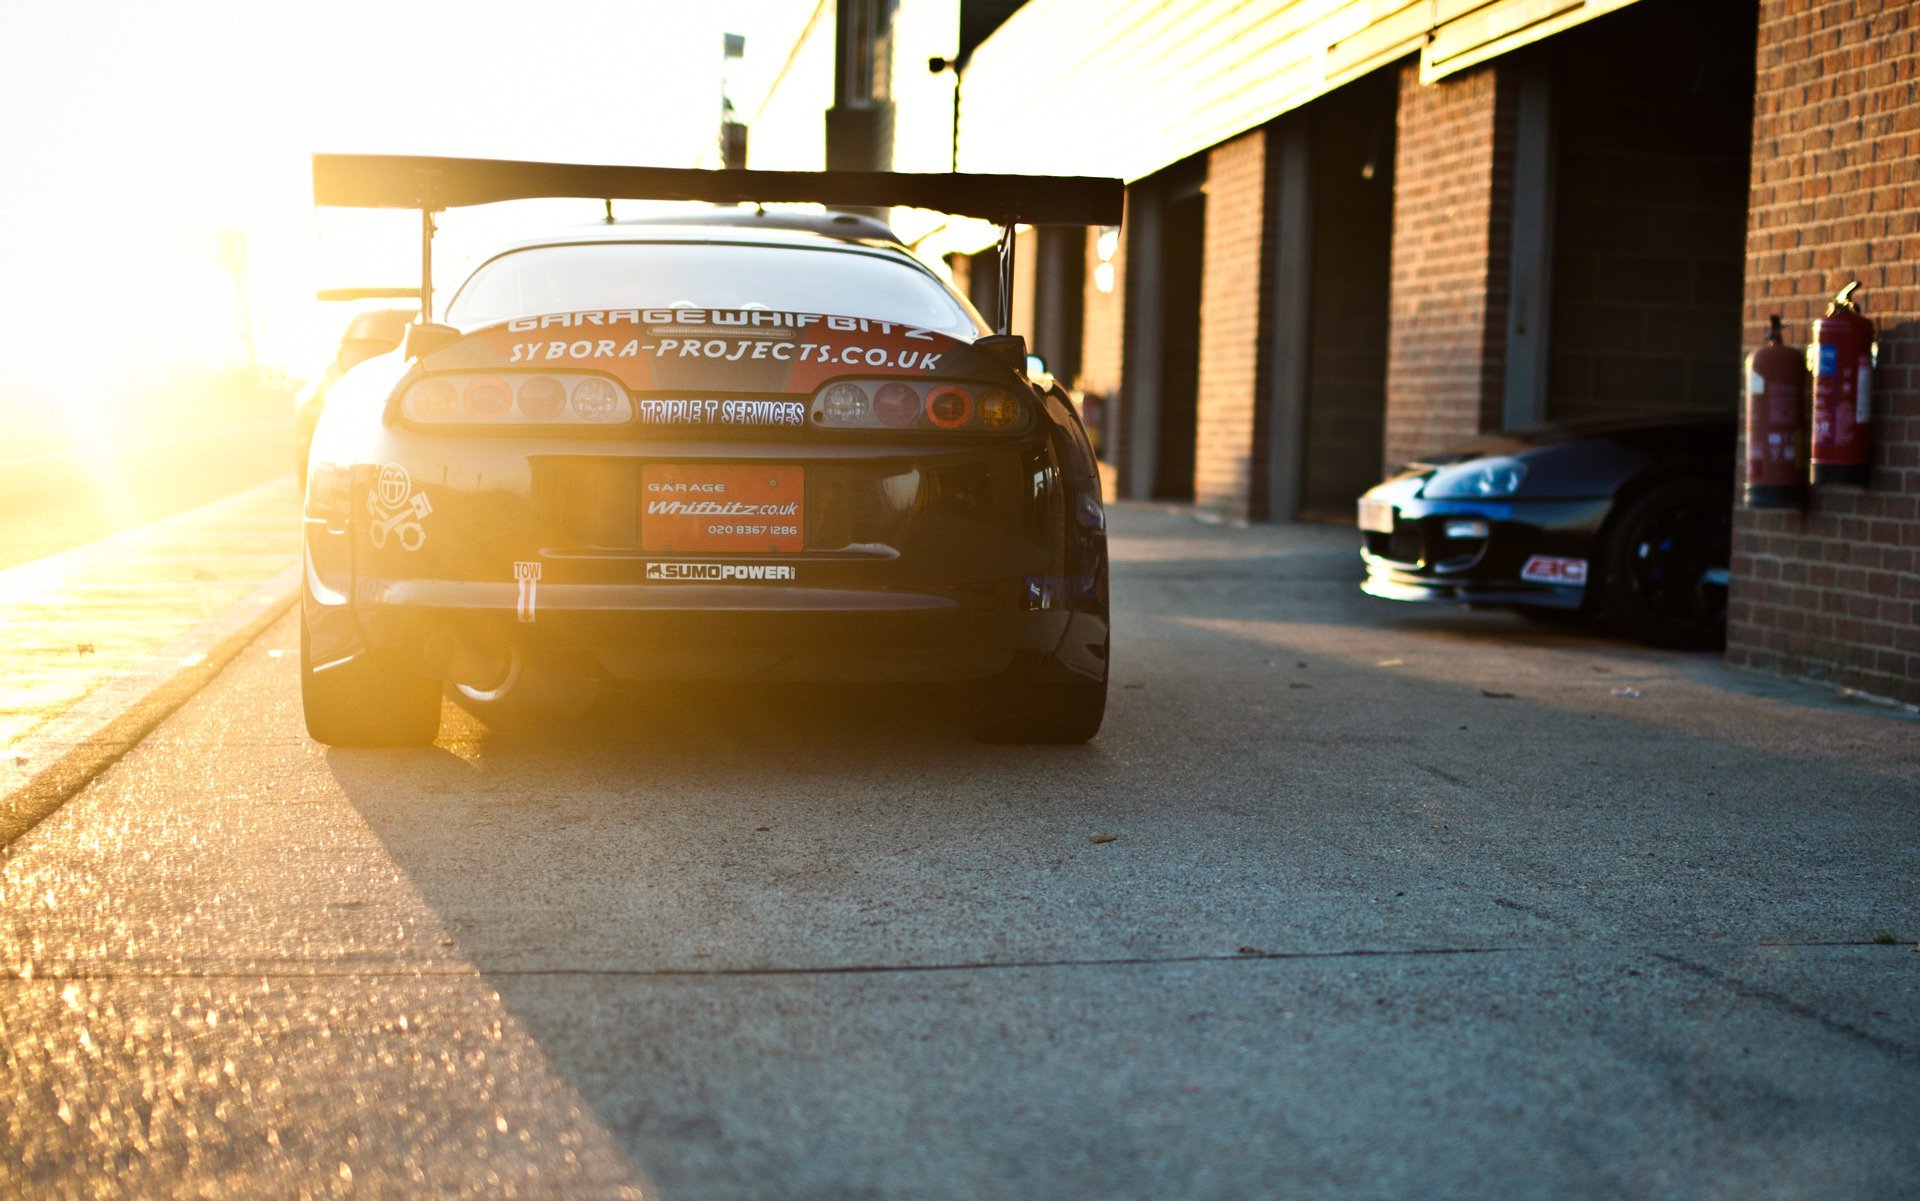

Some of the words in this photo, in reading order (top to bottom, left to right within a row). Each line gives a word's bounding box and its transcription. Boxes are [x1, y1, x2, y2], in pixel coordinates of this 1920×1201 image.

[509, 338, 942, 371] SYBORA-PROJECTS.CO.UK
[641, 400, 701, 424] TRIPLE
[705, 400, 718, 424] T
[721, 401, 804, 426] SERVICES
[648, 483, 725, 492] GARAGE
[647, 501, 798, 515] Whifbitz.co.uk
[708, 525, 733, 535] 020
[736, 525, 766, 535] 8367
[770, 525, 798, 535] 1286
[516, 563, 540, 578] TOW
